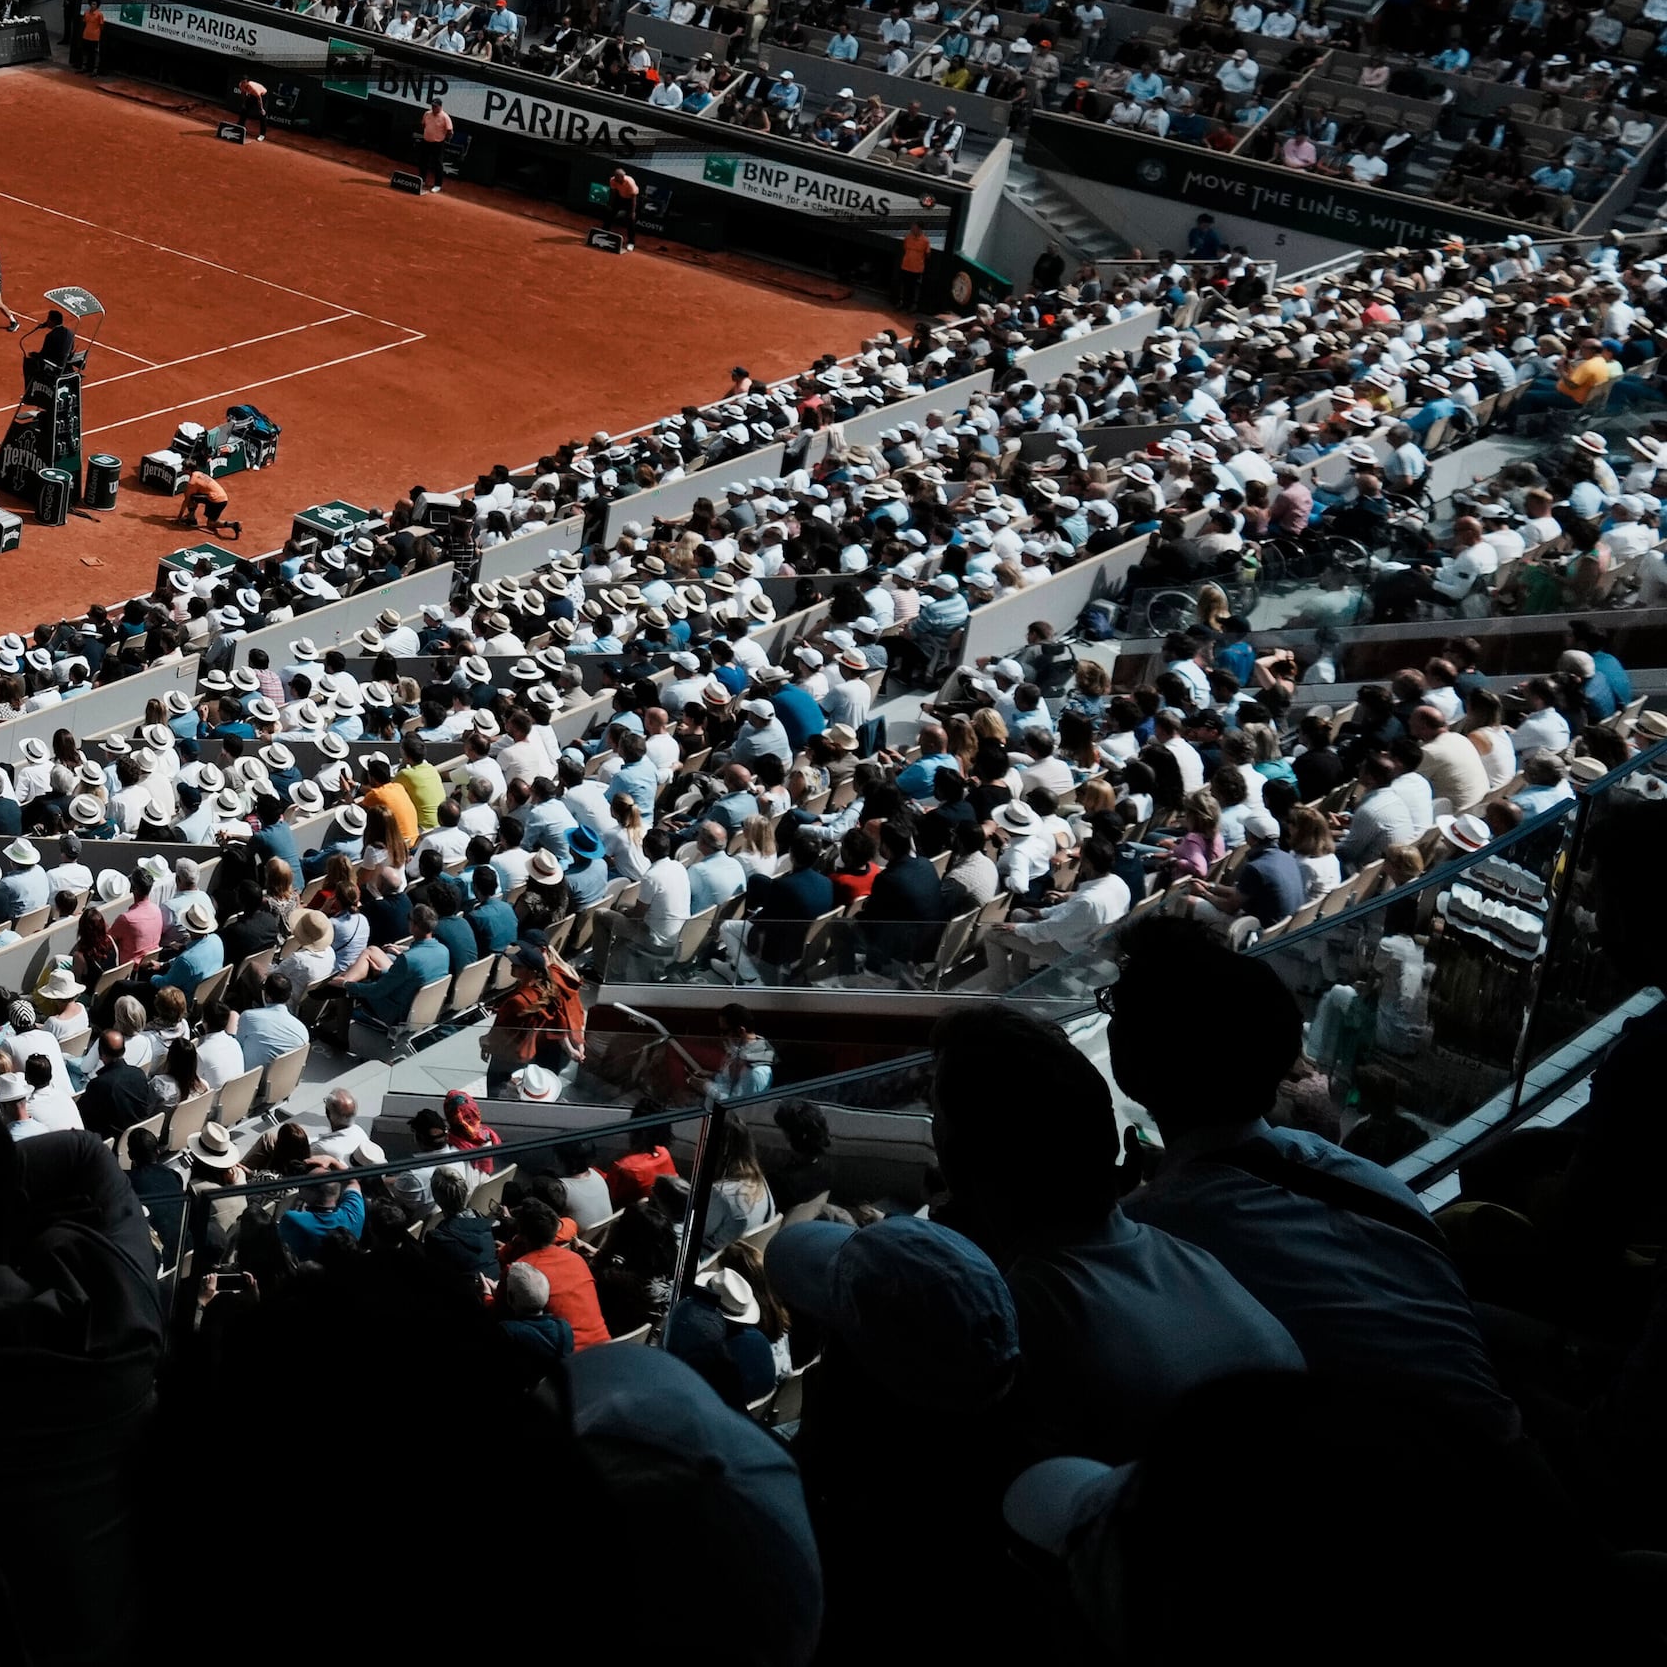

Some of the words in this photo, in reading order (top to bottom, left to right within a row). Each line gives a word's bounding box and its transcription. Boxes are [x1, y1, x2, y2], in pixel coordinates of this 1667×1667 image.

[149, 3, 183, 25] BNP
[187, 13, 258, 46] PARIBAS
[377, 62, 449, 104] BNP
[483, 89, 638, 153] PARIBAS
[743, 162, 789, 188] BNP
[794, 176, 890, 217] PARIBAS
[761, 188, 784, 201] bank
[785, 194, 800, 206] for
[1181, 170, 1247, 197] MOVE
[1250, 185, 1292, 211] THE
[1297, 195, 1363, 227] LINES,
[1369, 214, 1426, 246] WITH
[635, 219, 665, 232] ACOSTE
[86, 469, 100, 504] Wilson
[142, 462, 175, 485] perrier
